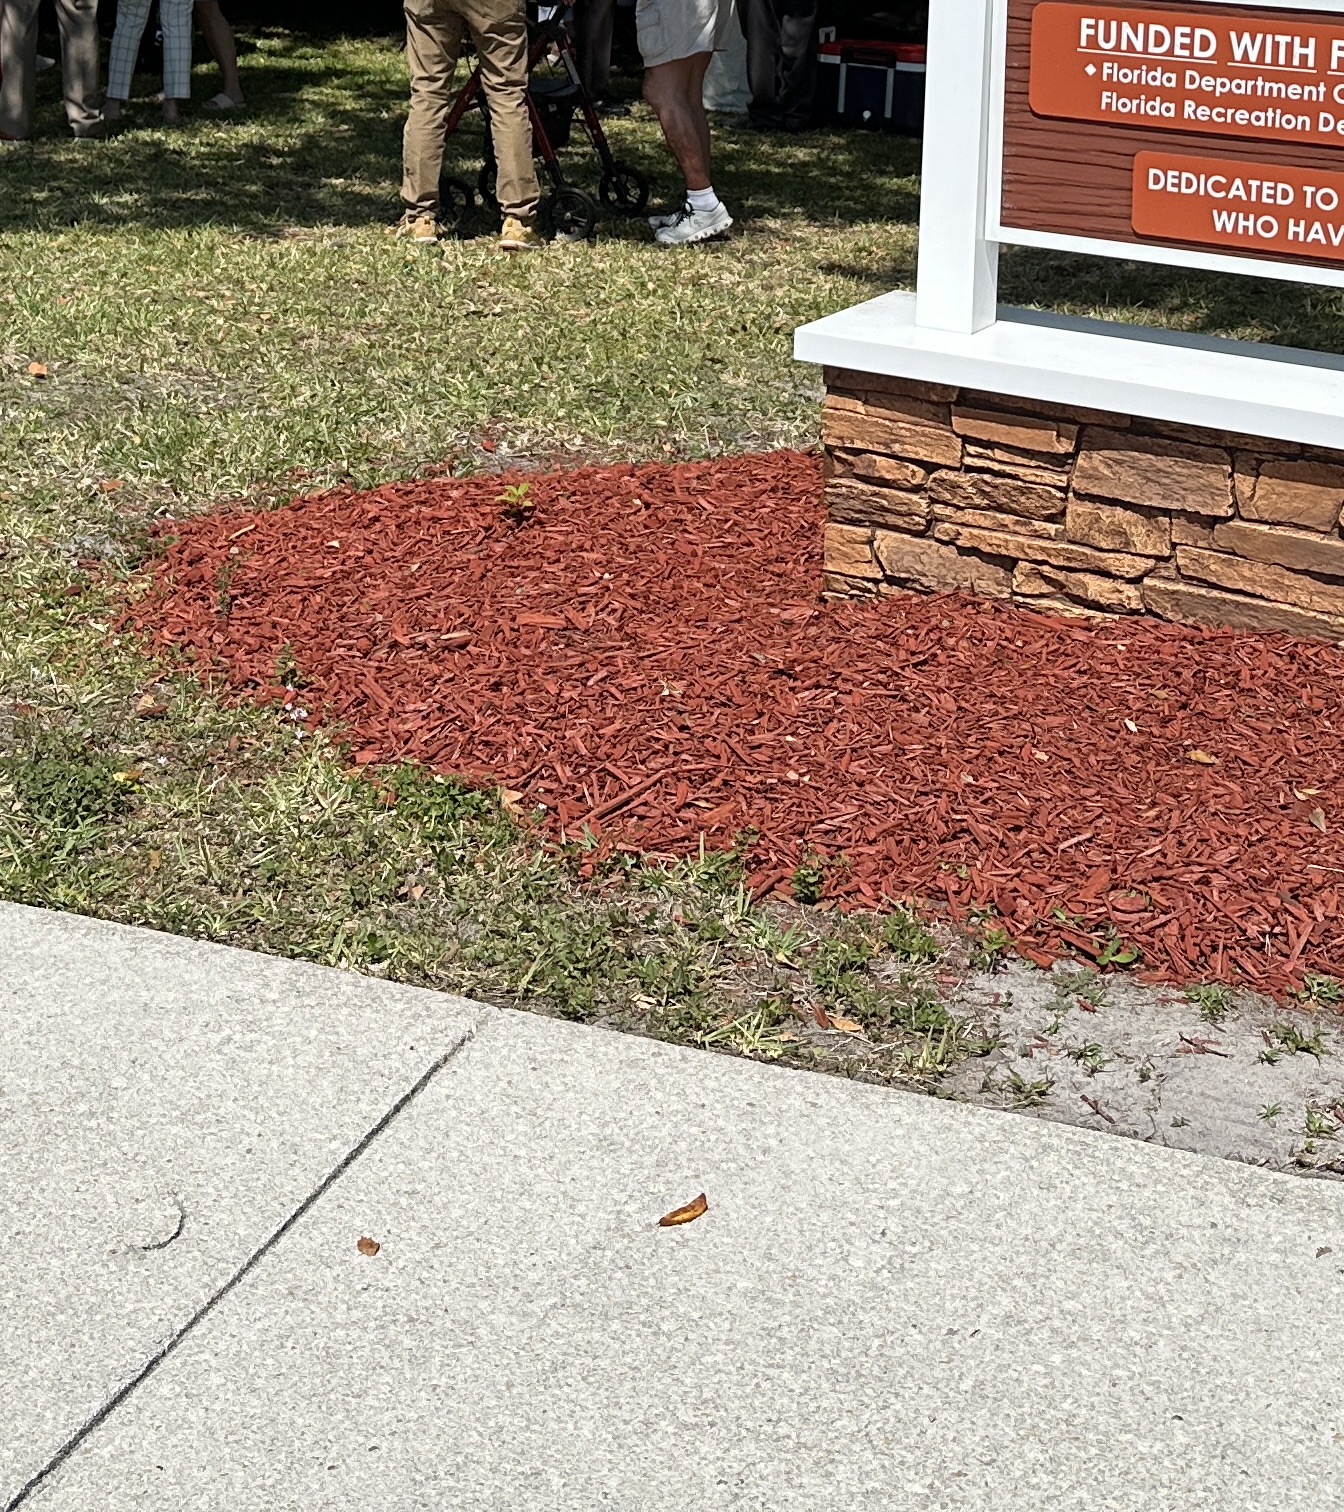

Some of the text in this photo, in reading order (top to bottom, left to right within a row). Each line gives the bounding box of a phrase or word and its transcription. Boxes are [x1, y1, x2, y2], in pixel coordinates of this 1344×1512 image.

[1077, 17, 1217, 60] FUNDED
[1228, 30, 1317, 70] WITH
[1102, 61, 1176, 88] Florida
[1185, 69, 1327, 103] Department
[1100, 91, 1175, 117] Florida
[1183, 102, 1311, 131] Recreation
[1148, 168, 1294, 206] DEDICATED
[1303, 185, 1340, 211] TO
[1212, 209, 1279, 239] WHO
